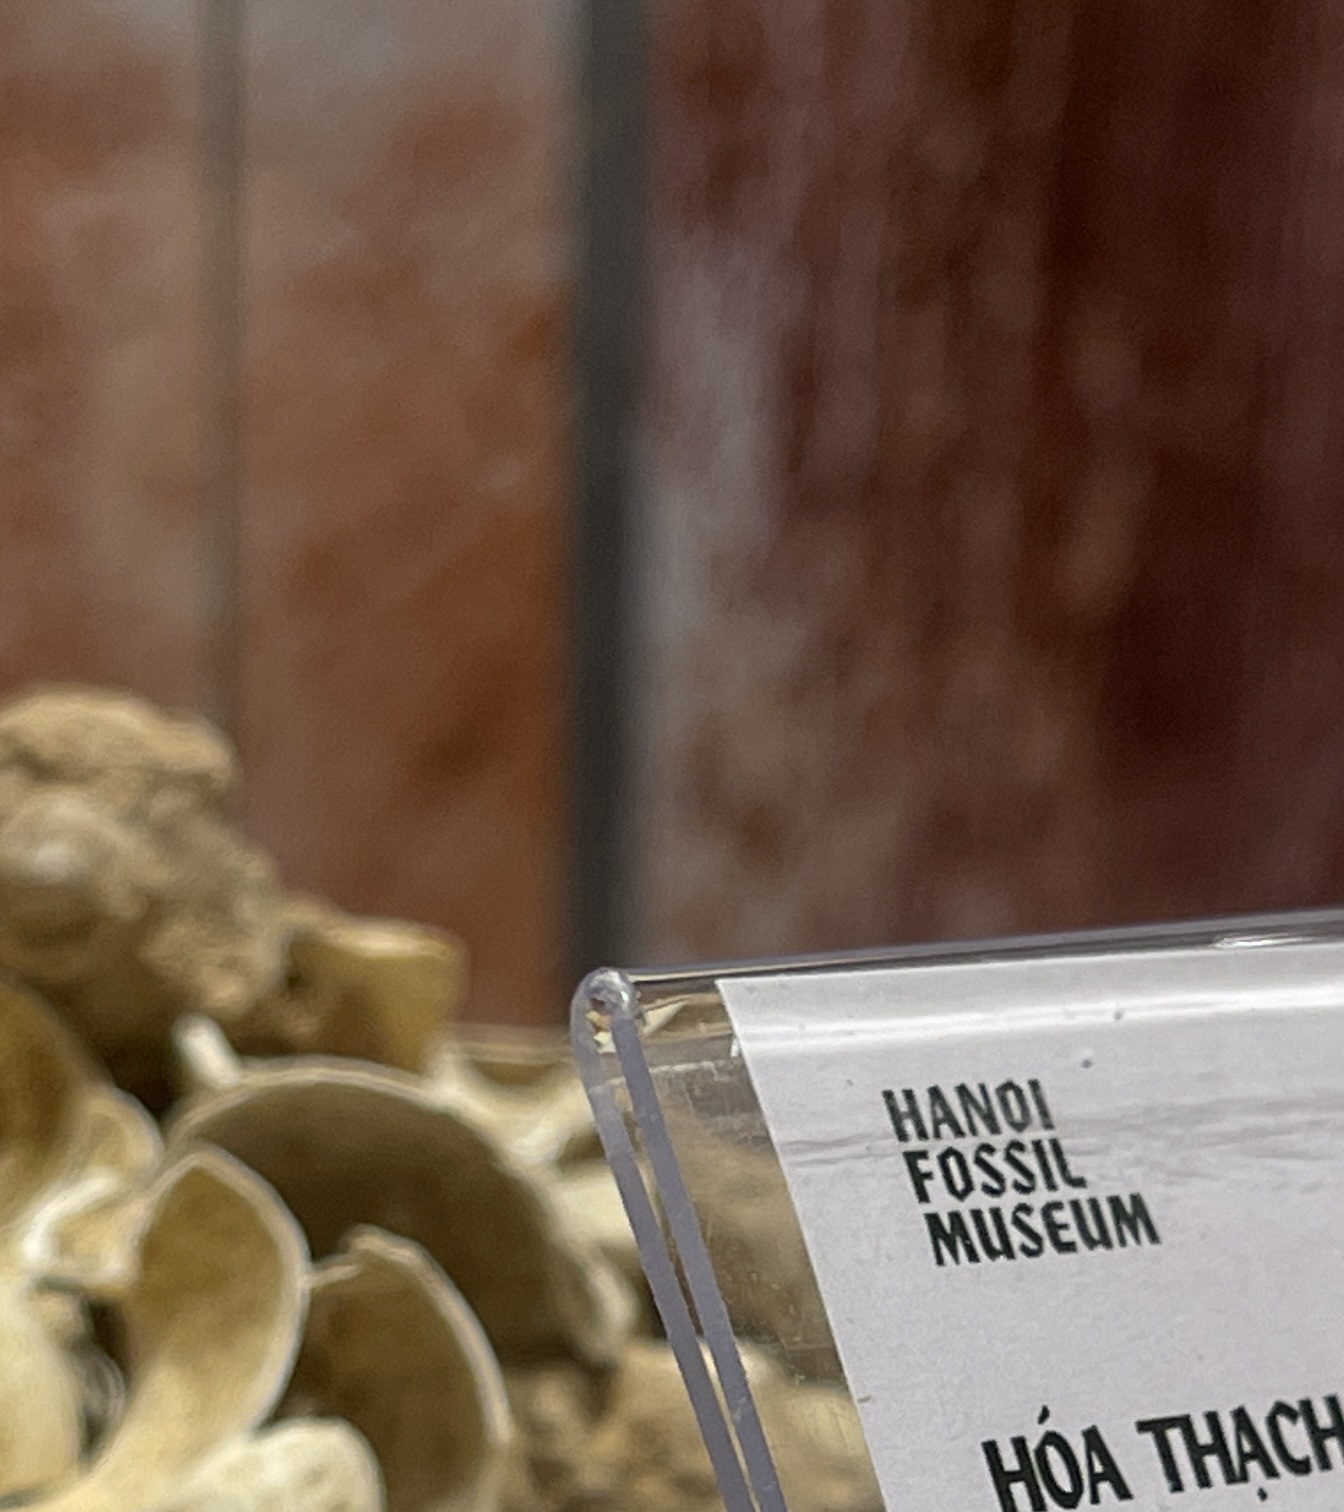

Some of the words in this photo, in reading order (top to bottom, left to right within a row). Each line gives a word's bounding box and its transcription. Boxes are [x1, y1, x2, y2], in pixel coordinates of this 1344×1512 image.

[881, 1078, 1055, 1142] HANOI
[902, 1138, 1087, 1203] FOSSIL
[923, 1193, 1162, 1266] MUSEUM
